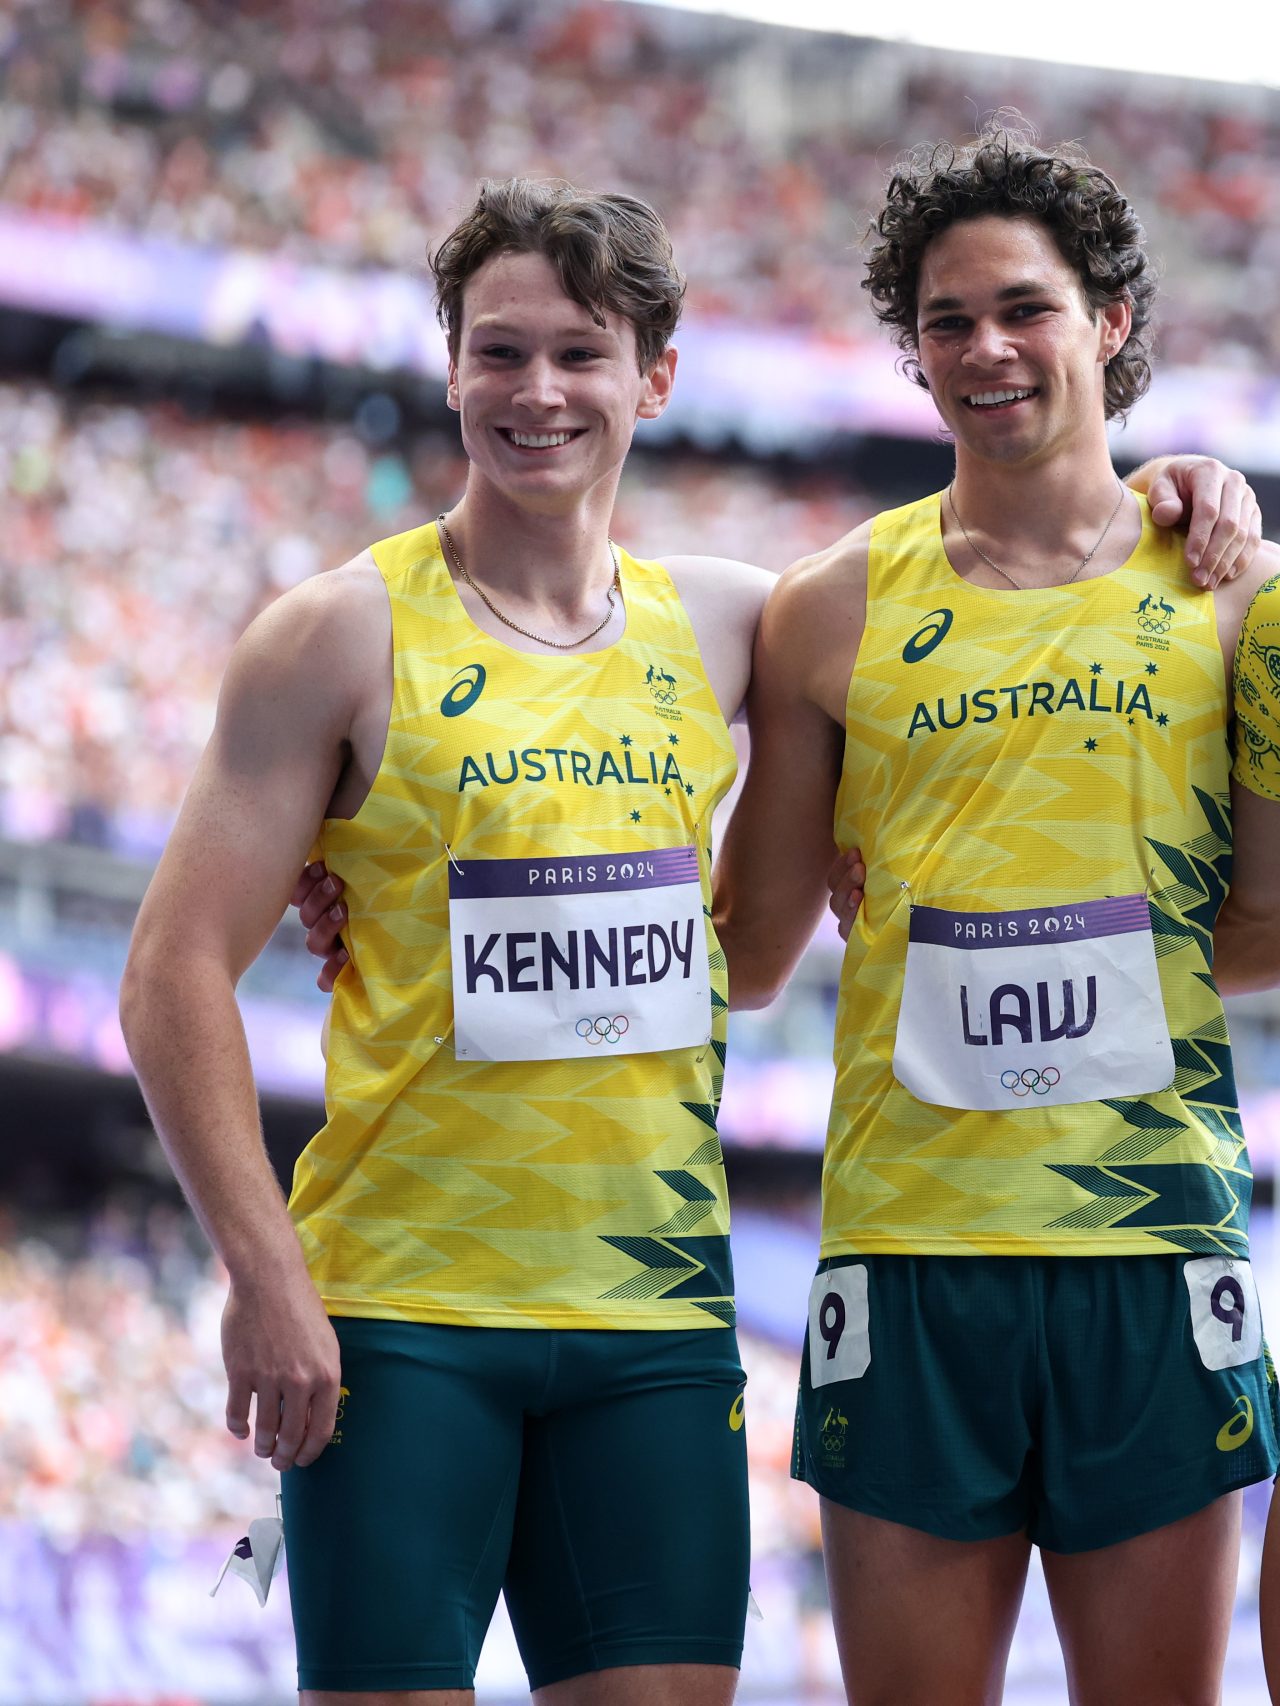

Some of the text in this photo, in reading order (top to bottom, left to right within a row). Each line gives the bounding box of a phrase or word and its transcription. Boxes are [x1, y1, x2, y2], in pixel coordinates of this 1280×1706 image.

[1136, 635, 1170, 645] AUSTRALIA
[907, 678, 1154, 738] AUSTRALIA
[458, 748, 684, 792] AUSTRALIA
[606, 864, 654, 881] 2024
[1029, 914, 1086, 934] 2024
[464, 918, 694, 994] KENNEDY
[960, 975, 1097, 1046] LAW
[818, 1291, 846, 1361] 9
[1210, 1275, 1246, 1343] 9
